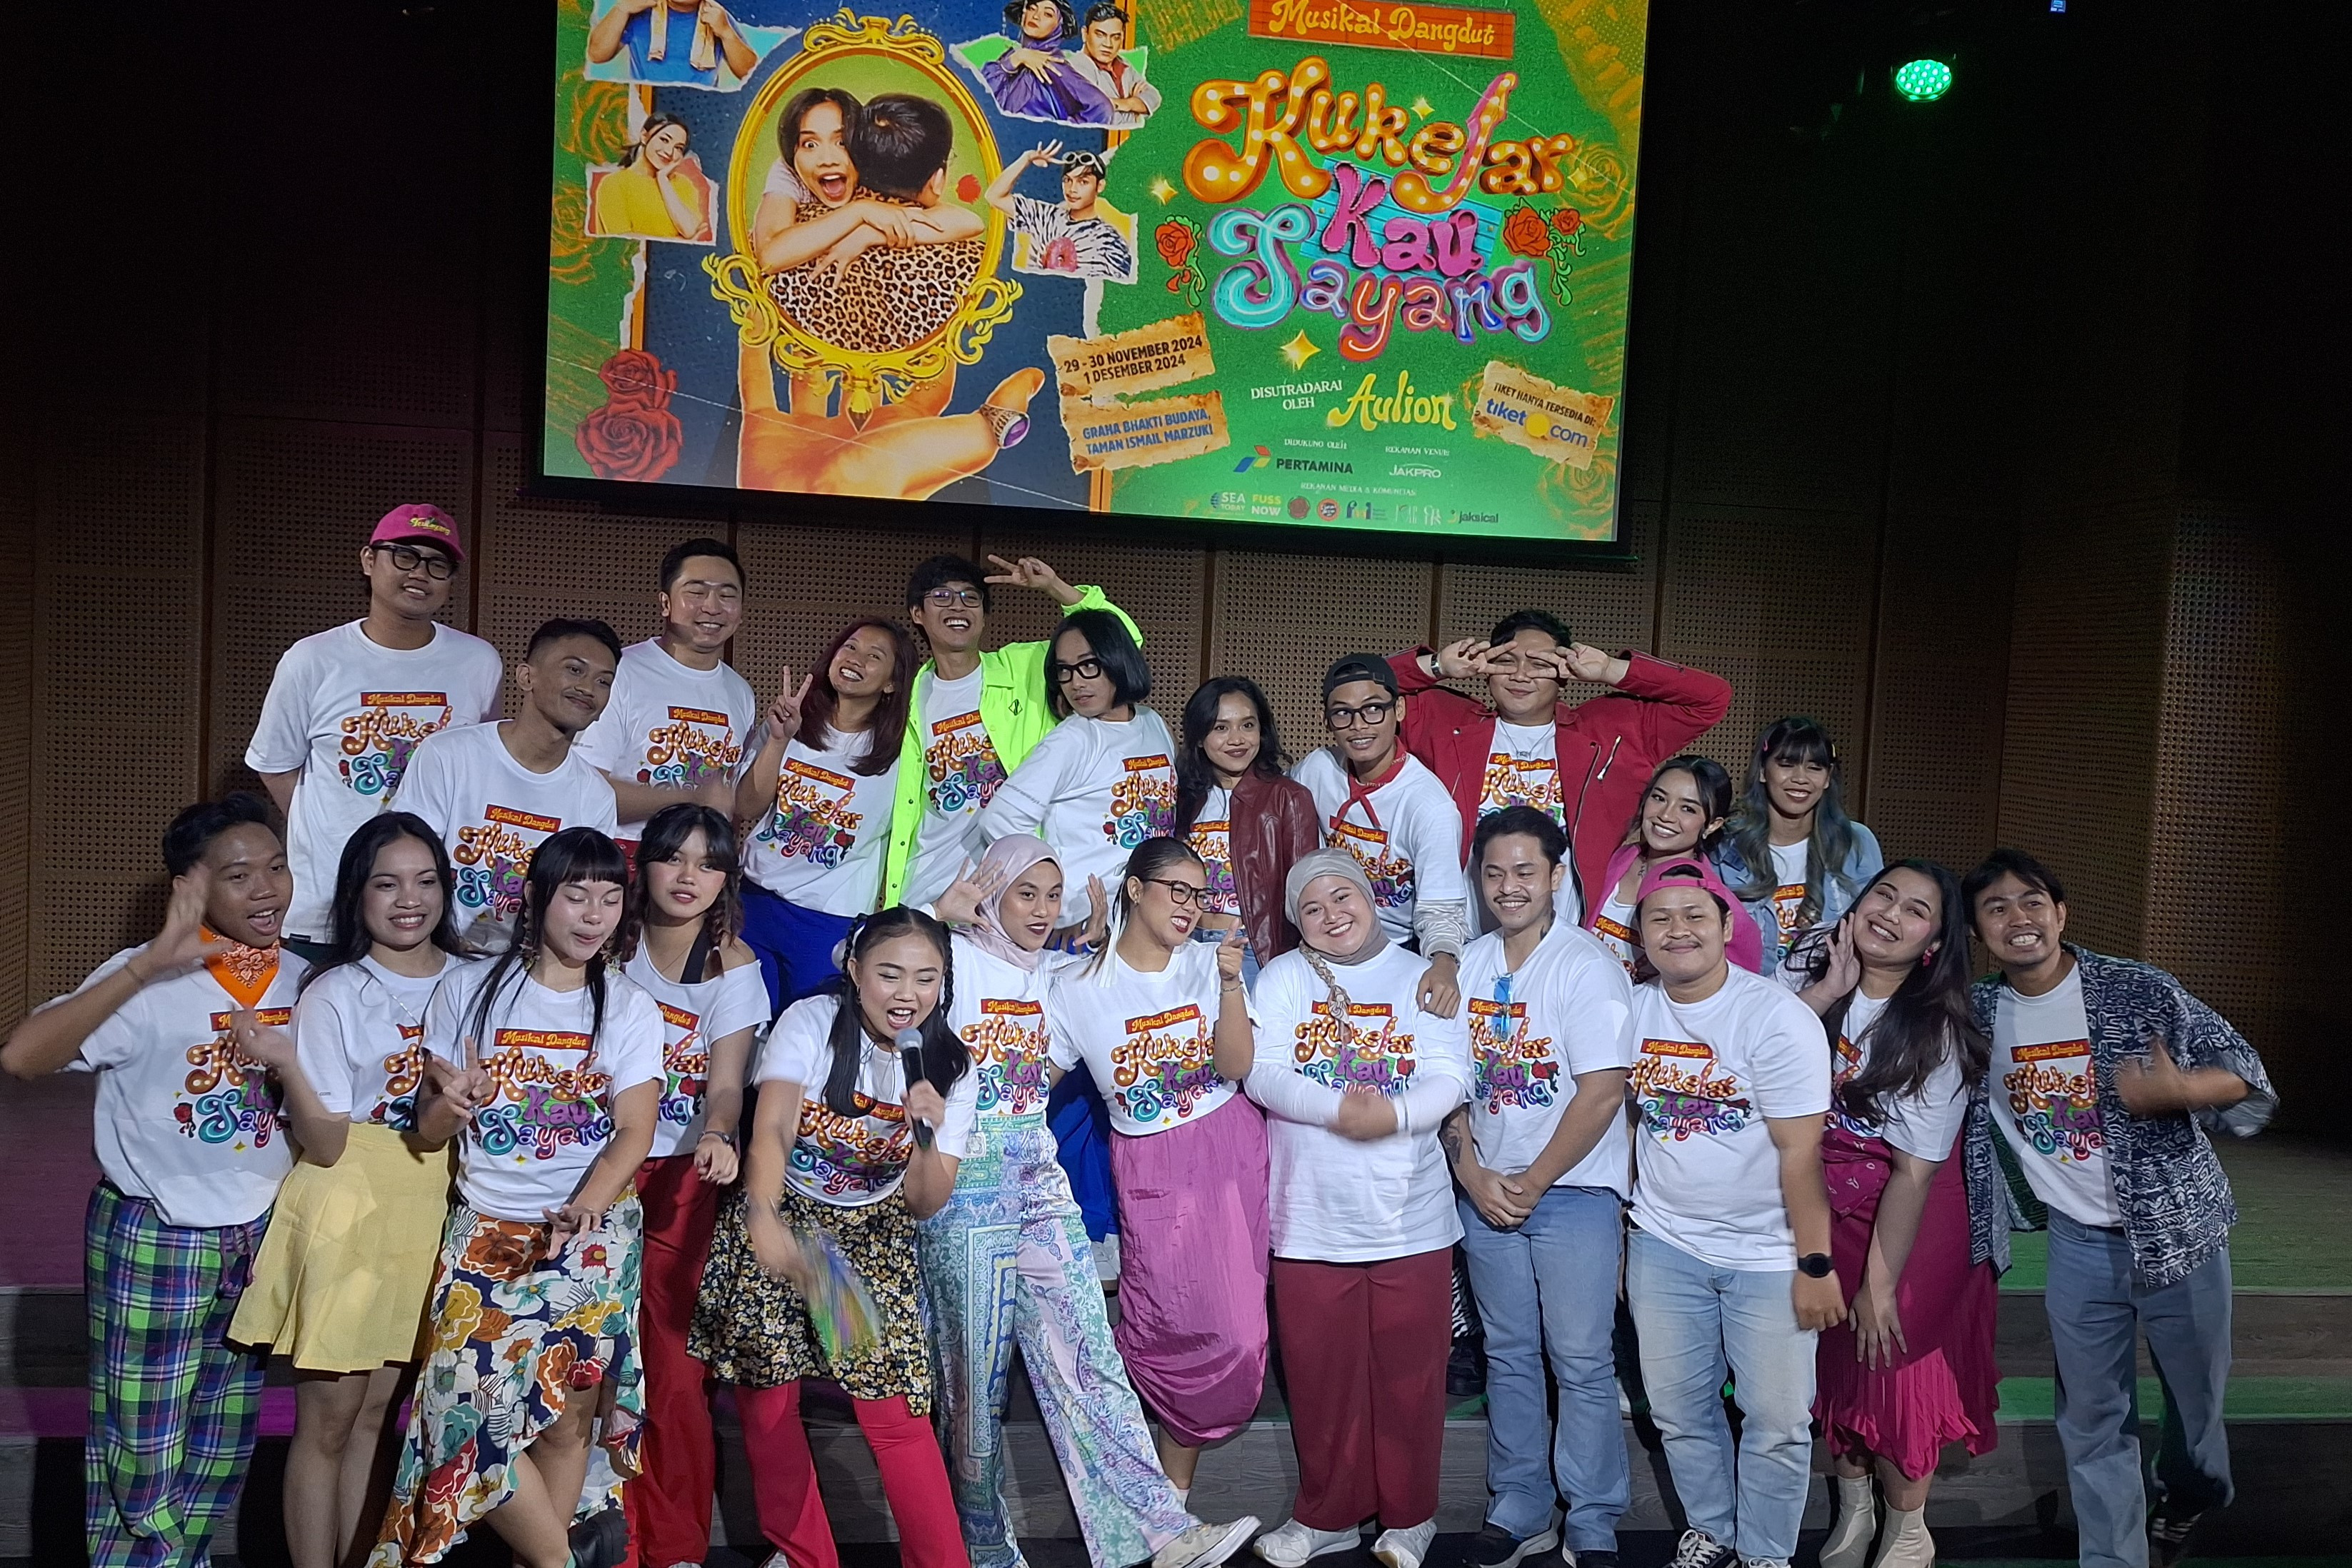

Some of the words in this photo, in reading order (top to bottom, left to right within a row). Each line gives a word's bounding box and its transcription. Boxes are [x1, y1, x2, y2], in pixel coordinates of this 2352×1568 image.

[1268, 0, 1381, 34] Musikal
[1388, 6, 1495, 52] Dangdut
[1207, 203, 1552, 362] Sayang
[1064, 359, 1079, 373] 29
[1089, 354, 1105, 368] 30
[1106, 341, 1170, 363] NOVEMBER
[1171, 335, 1203, 352] 2024
[1084, 373, 1091, 384] 1
[1094, 362, 1154, 383] DESEMBER
[1154, 353, 1186, 371] 2024
[1251, 379, 1343, 400] DISUTRADARAI
[1282, 397, 1315, 411] OLEH
[1327, 370, 1457, 431] Aulion
[1493, 382, 1517, 398] TIKET
[1516, 390, 1544, 409] HANYA
[1545, 401, 1583, 423] TERSEDIA
[1083, 423, 1121, 440] GRAHA
[1123, 416, 1163, 433] BHAKTI
[1165, 408, 1211, 426] BUDAYA,
[1086, 440, 1124, 456] TAMAN
[1126, 433, 1163, 449] ISMAIL
[1164, 423, 1213, 443] MARZUKI
[1385, 446, 1421, 455] REKANAN
[1276, 458, 1353, 474] PERTAMINA
[1389, 464, 1441, 478] JAKPRO
[1301, 482, 1336, 491] REKANAN
[1221, 491, 1246, 504] SEA
[1221, 503, 1245, 512] TODAY
[1252, 494, 1282, 505] FUSS
[1251, 506, 1281, 516] NOW
[524, 1085, 593, 1127] Kau
